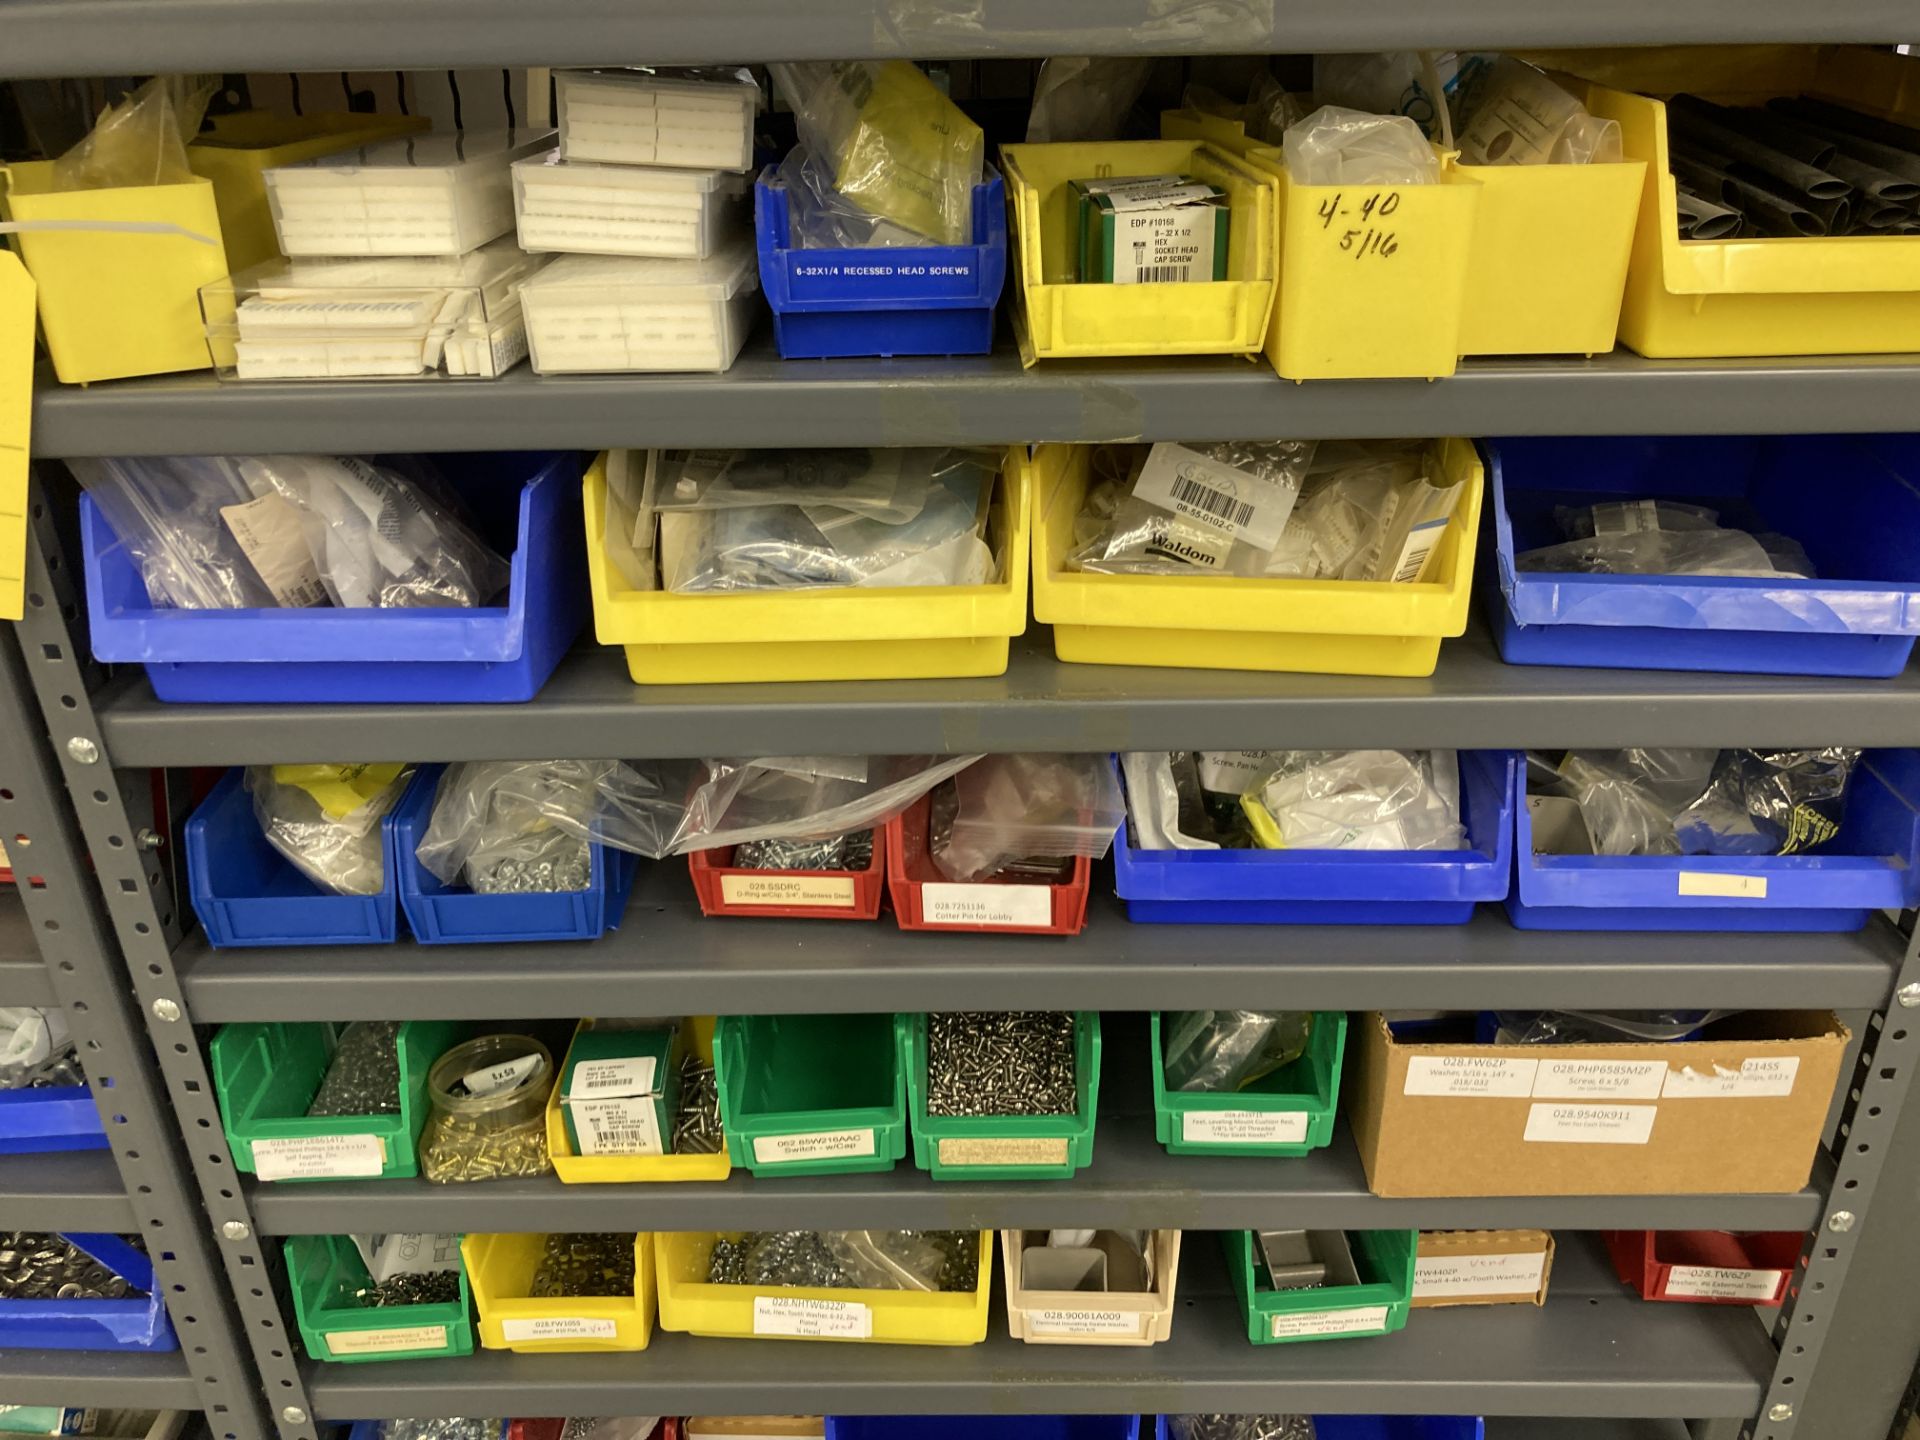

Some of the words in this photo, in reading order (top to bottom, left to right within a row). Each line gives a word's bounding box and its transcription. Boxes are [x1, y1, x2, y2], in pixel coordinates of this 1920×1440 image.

[1131, 219, 1147, 228] EDP
[1339, 228, 1398, 259] 5/16
[1181, 246, 1198, 254] HEAD
[1154, 256, 1168, 264] CAP
[796, 266, 839, 276] 6-32X1/4
[844, 266, 893, 276] RECESSED
[897, 266, 926, 276] HEAD
[929, 266, 969, 276] SCREWS
[1175, 502, 1235, 533] 08-55-0102-C
[1150, 532, 1216, 567] Waldom
[1212, 757, 1236, 768] Screw,
[936, 912, 960, 920] Cotter
[962, 912, 974, 920] Pin
[975, 912, 986, 920] for
[1044, 1312, 1121, 1320] 028.90061A009
